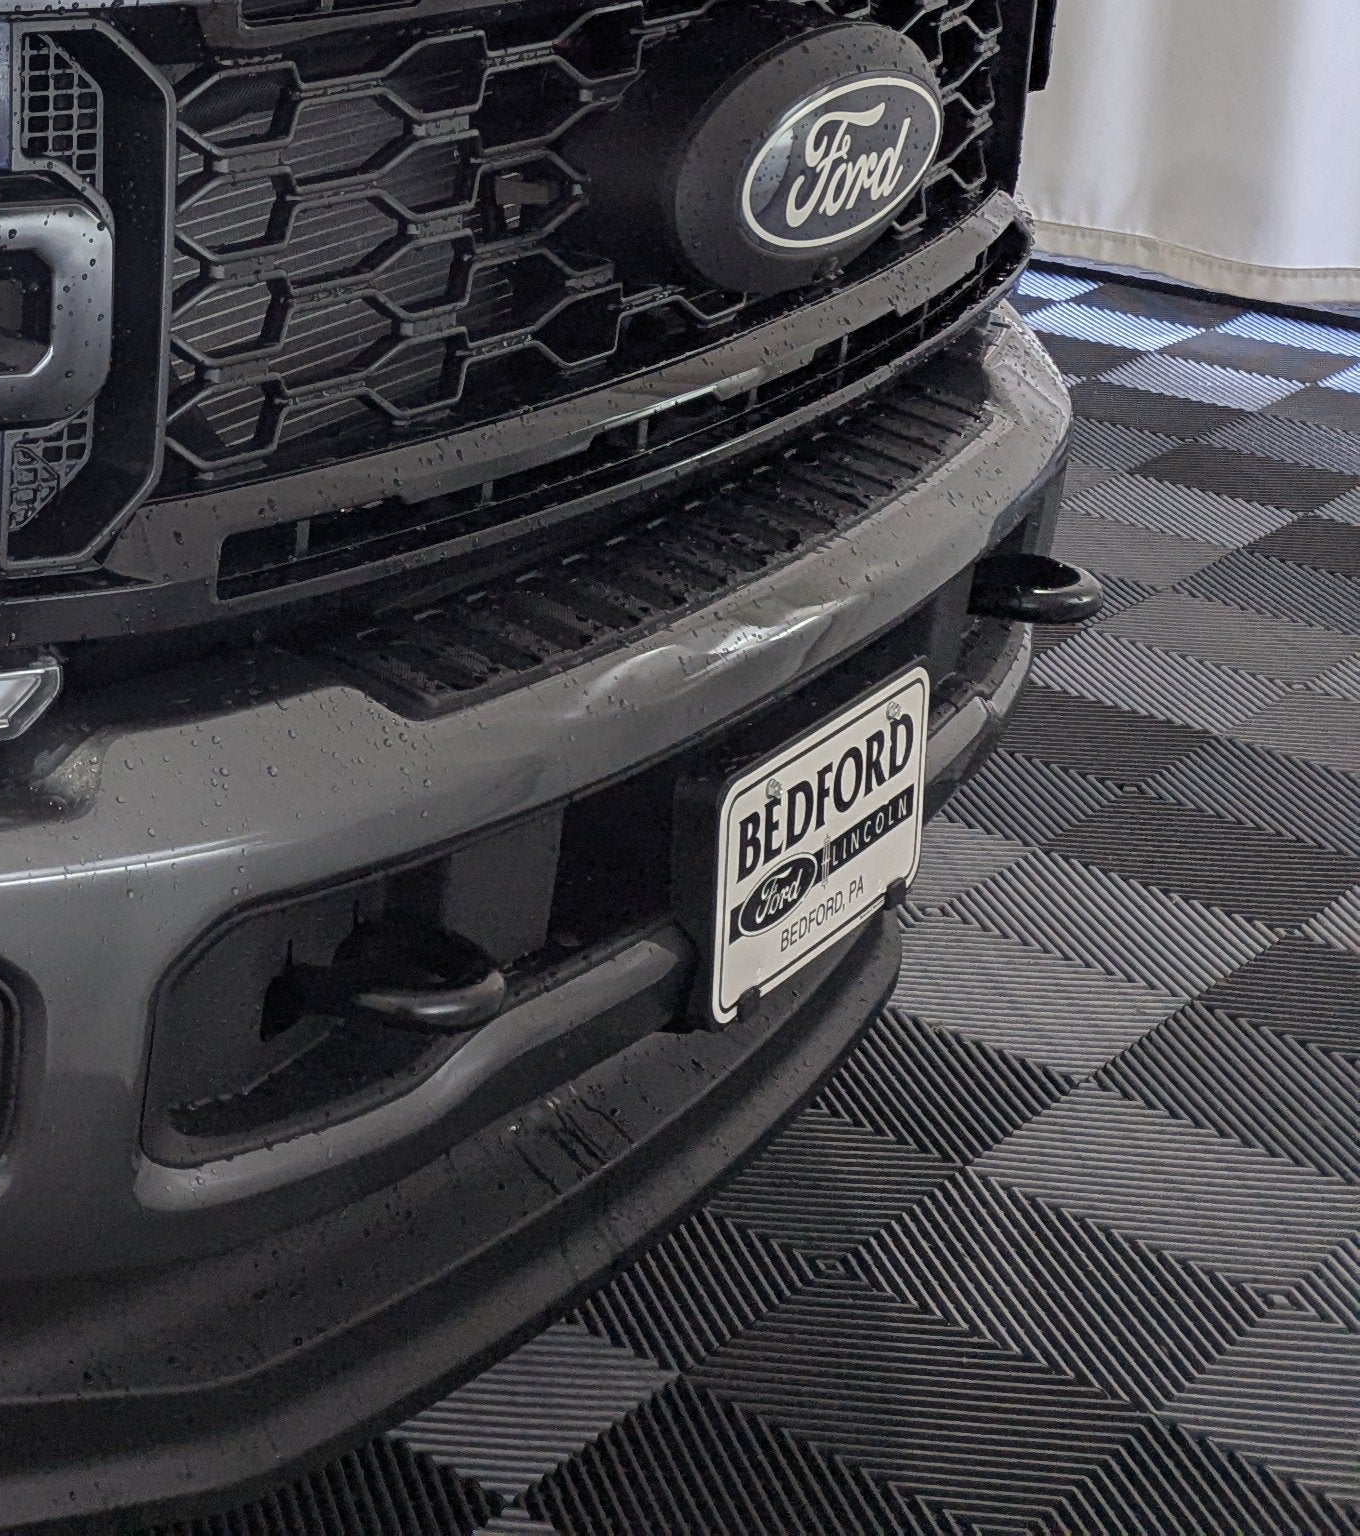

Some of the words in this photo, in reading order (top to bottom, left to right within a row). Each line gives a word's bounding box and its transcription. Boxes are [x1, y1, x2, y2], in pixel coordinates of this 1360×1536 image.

[785, 102, 912, 228] Ford
[736, 713, 914, 884] BEDFORD
[831, 794, 908, 866] LINCOLN
[755, 866, 804, 925] Ford
[780, 890, 846, 953] BEDFORD,
[848, 874, 865, 904] PA
